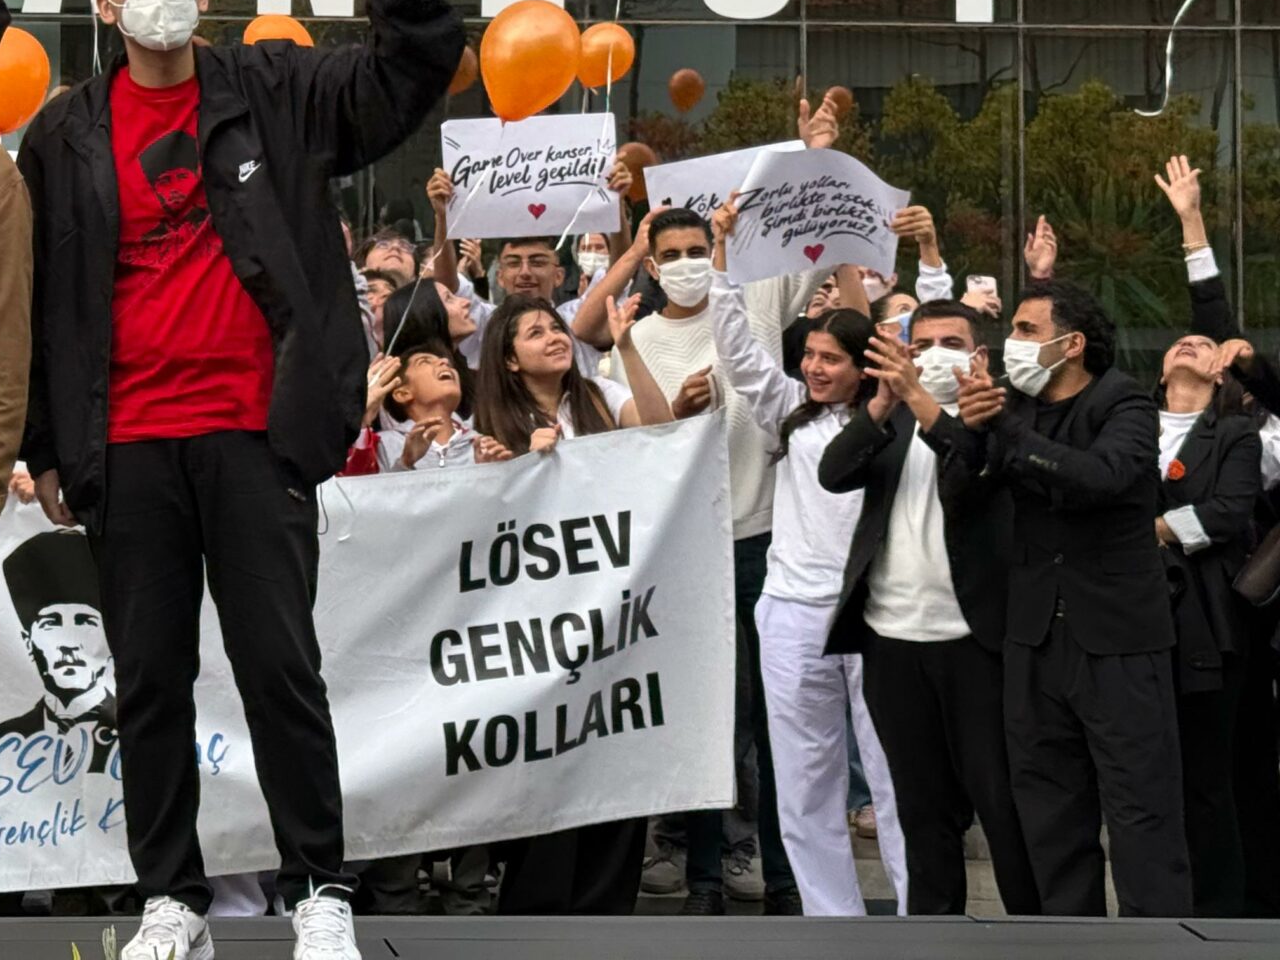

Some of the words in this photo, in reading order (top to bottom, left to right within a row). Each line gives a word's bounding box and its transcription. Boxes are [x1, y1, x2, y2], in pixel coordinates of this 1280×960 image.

[452, 154, 504, 188] Game
[506, 147, 542, 168] Over
[489, 164, 531, 194] level
[534, 157, 606, 192] geçildi!
[459, 510, 632, 593] LÖSEV
[429, 585, 660, 687] GENÇLİK
[443, 672, 665, 777] KOLLARI
